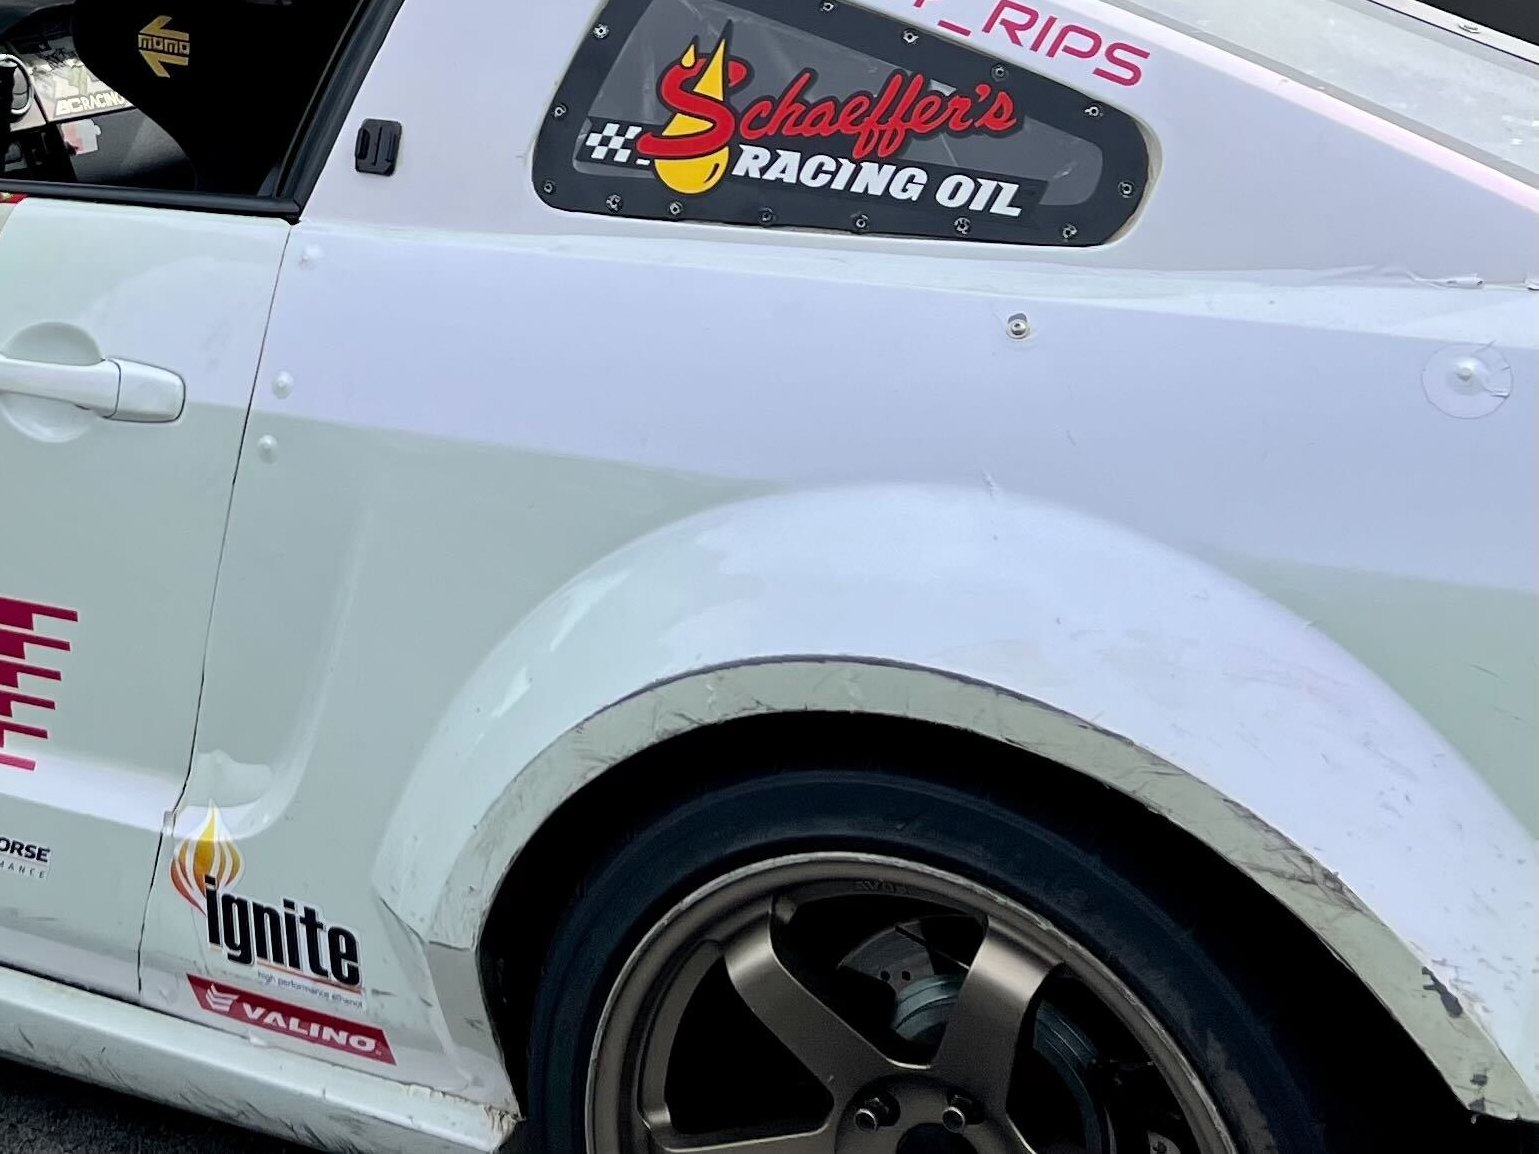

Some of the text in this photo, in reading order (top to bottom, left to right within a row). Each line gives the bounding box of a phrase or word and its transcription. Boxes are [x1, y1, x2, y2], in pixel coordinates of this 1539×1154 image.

[636, 57, 1017, 158] Schaeffer's
[731, 144, 1023, 218] RACING OIL
[205, 876, 360, 986] ignite
[242, 1002, 376, 1052] VALINO
